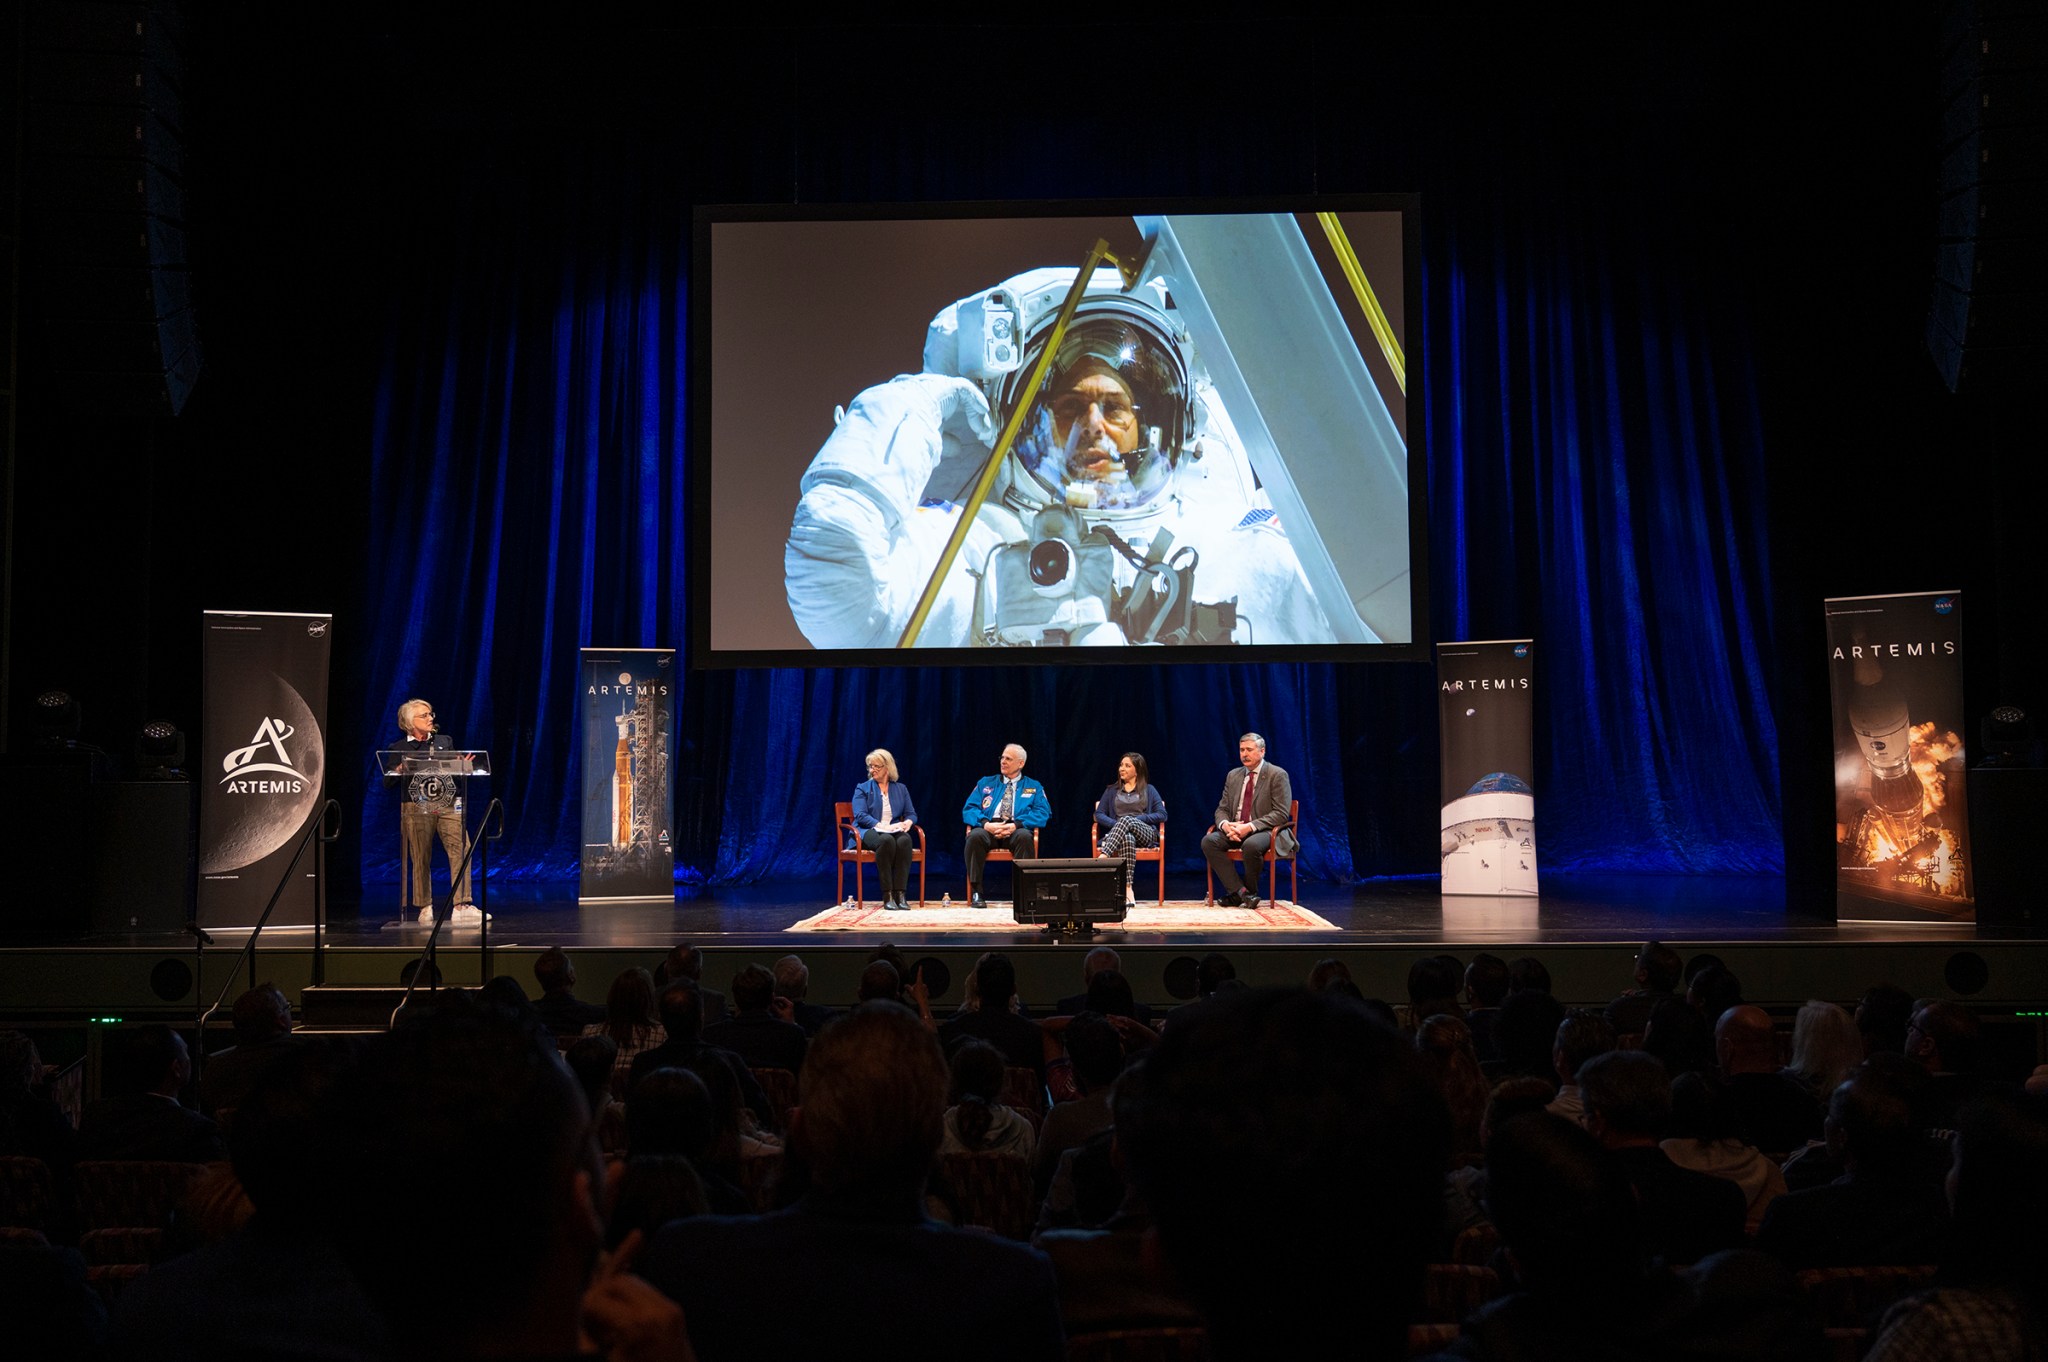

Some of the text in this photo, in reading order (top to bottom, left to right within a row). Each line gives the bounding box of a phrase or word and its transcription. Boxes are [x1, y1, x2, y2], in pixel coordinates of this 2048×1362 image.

[1833, 641, 1955, 660] ARTEMIS
[588, 685, 668, 696] ARTEMIS
[1442, 678, 1528, 691] ARTEMIS
[226, 780, 302, 794] ARTEMIS
